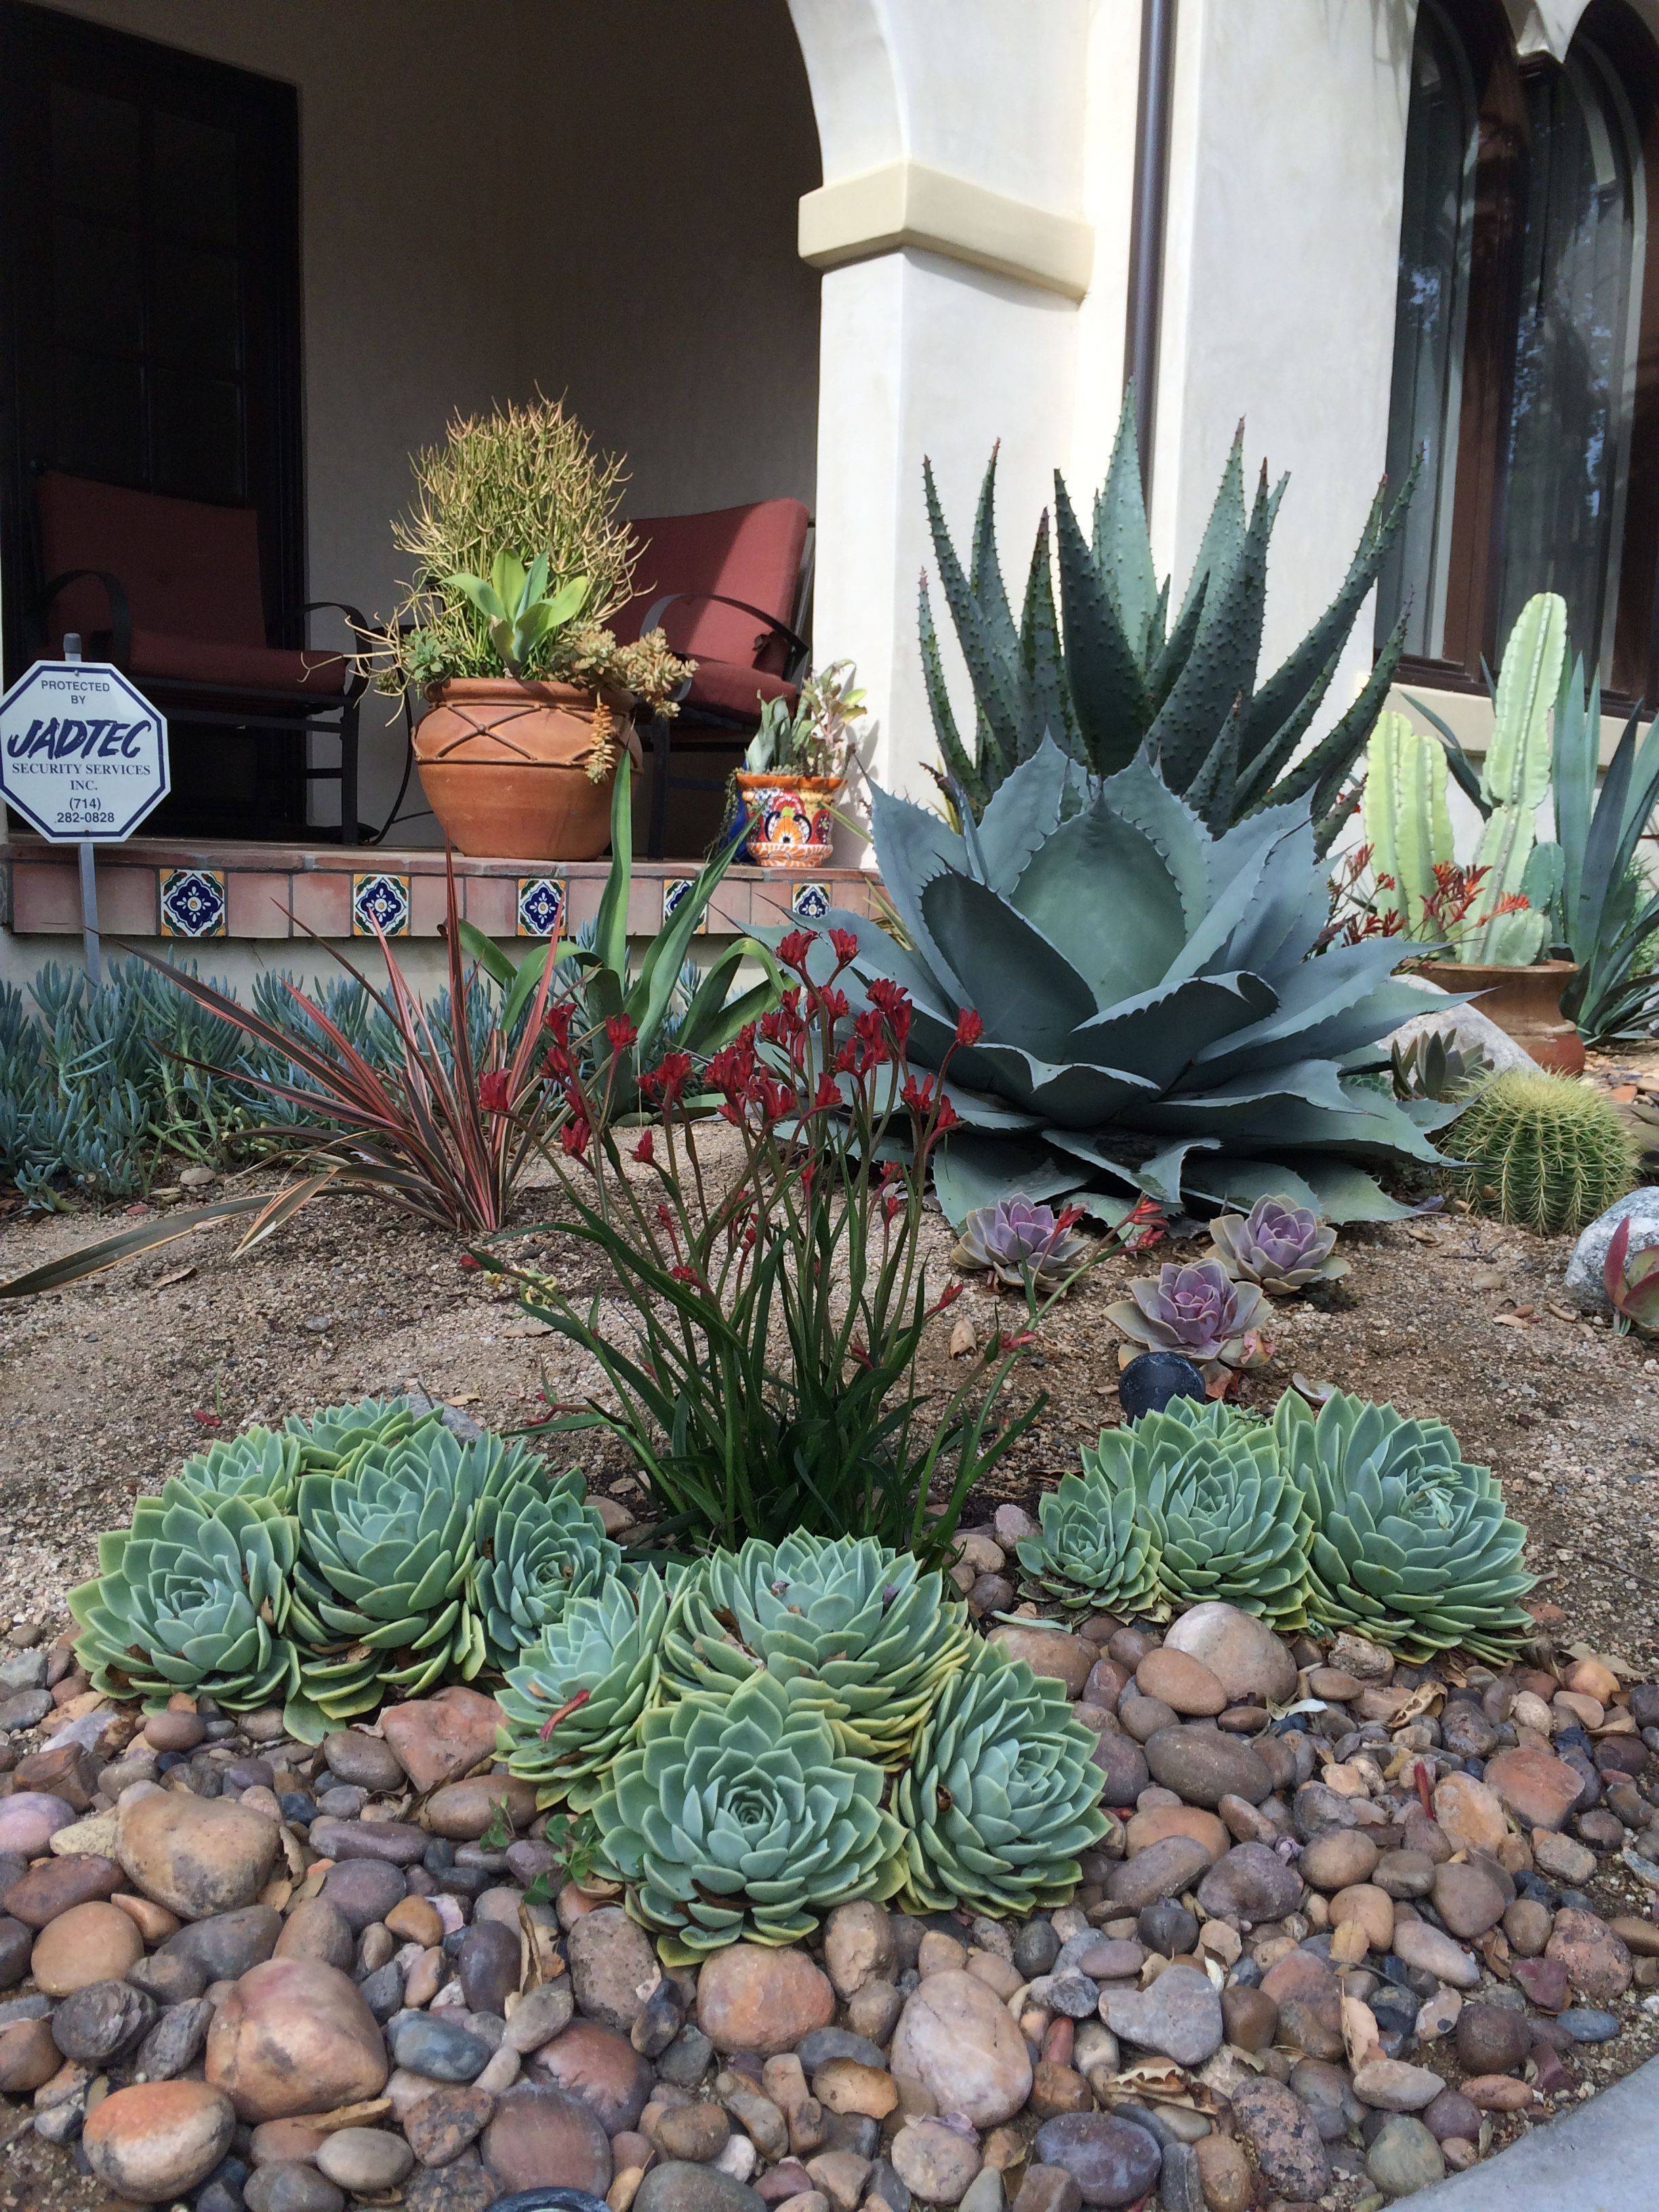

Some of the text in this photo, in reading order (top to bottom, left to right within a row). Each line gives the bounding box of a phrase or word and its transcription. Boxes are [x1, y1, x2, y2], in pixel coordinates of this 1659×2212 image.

[41, 680, 110, 692] PROTECTED
[70, 695, 85, 704] BY
[7, 717, 152, 760] JADTEC
[12, 763, 150, 775] SECURITY SERVICES
[70, 780, 98, 791] INC.
[69, 798, 101, 811] (714)
[57, 812, 115, 823] 282-0828
